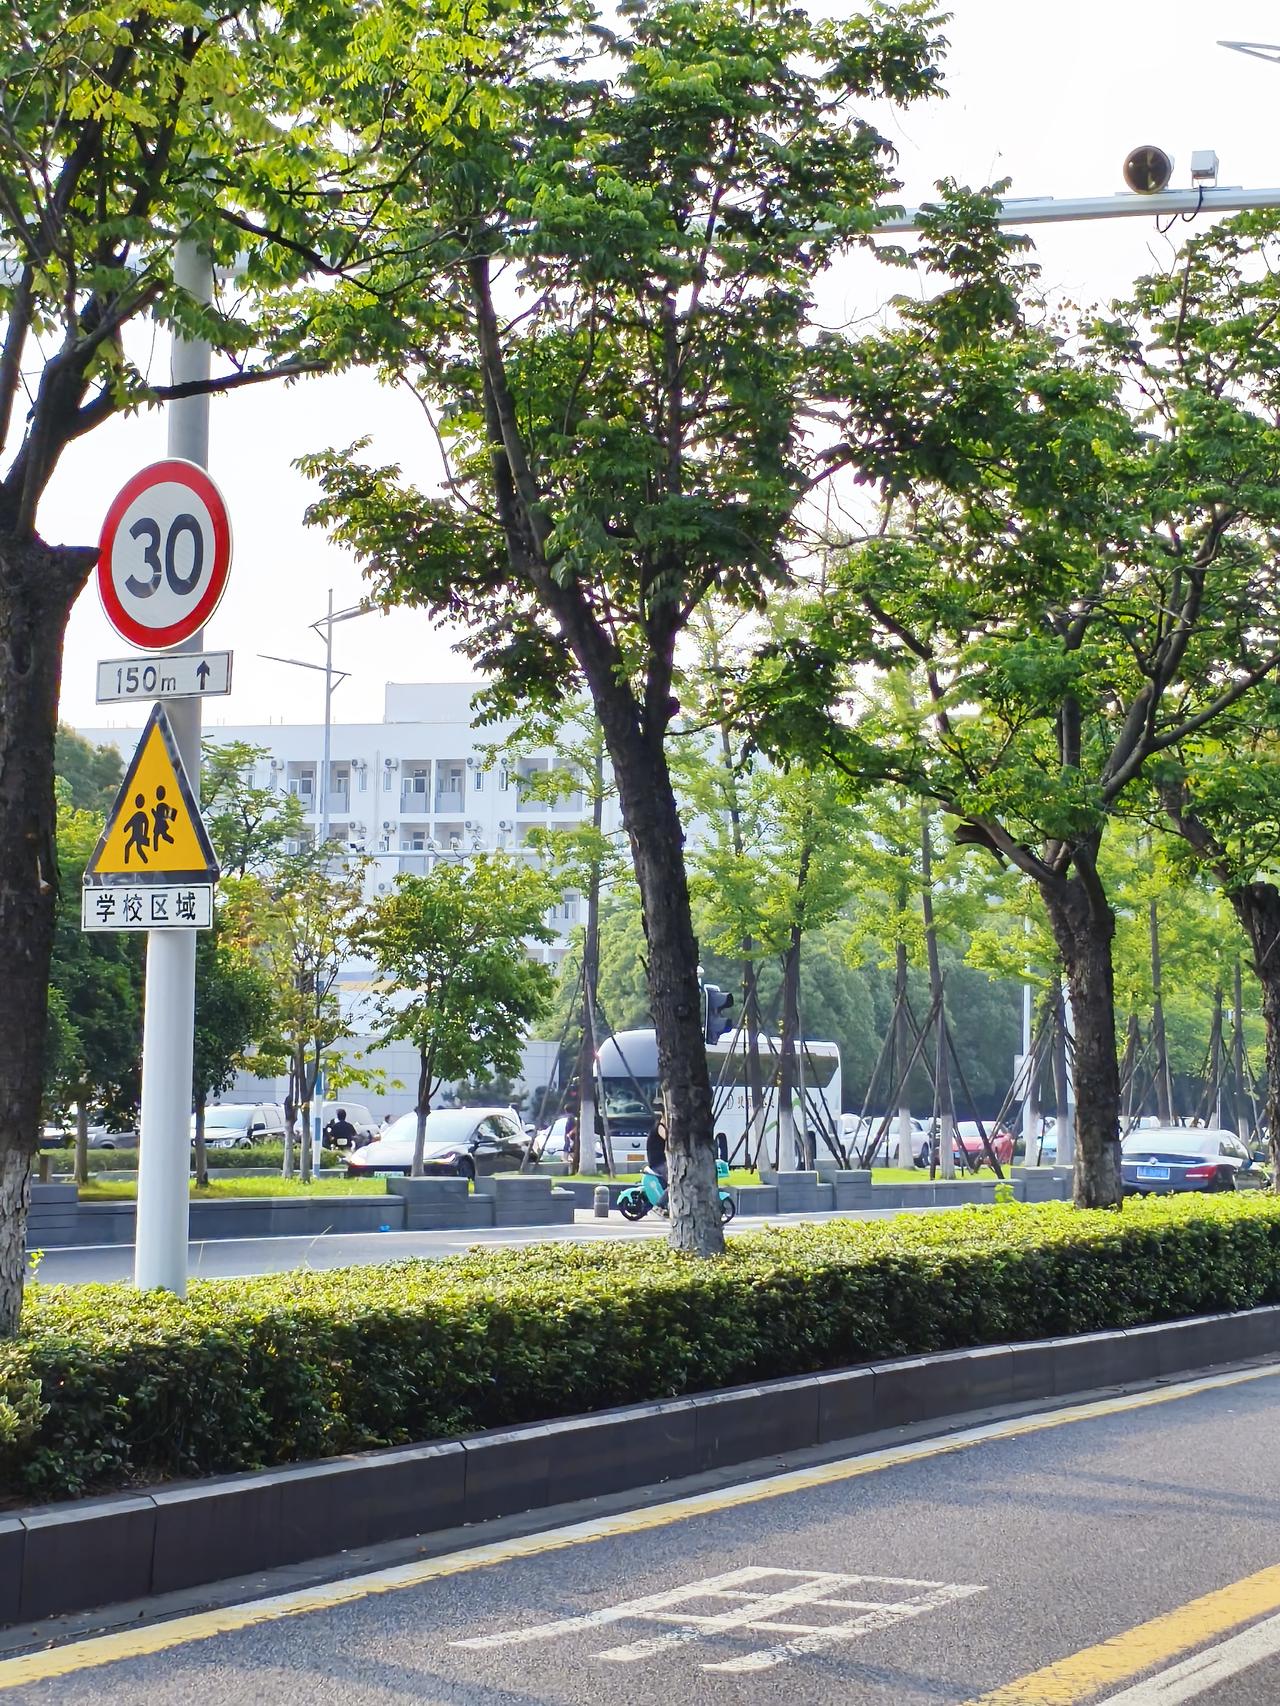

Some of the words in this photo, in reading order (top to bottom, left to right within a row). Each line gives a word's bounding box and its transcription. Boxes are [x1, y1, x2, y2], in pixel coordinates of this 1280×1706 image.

[125, 513, 204, 599] 30
[117, 666, 176, 694] 150m
[96, 891, 196, 923] 学校区域
